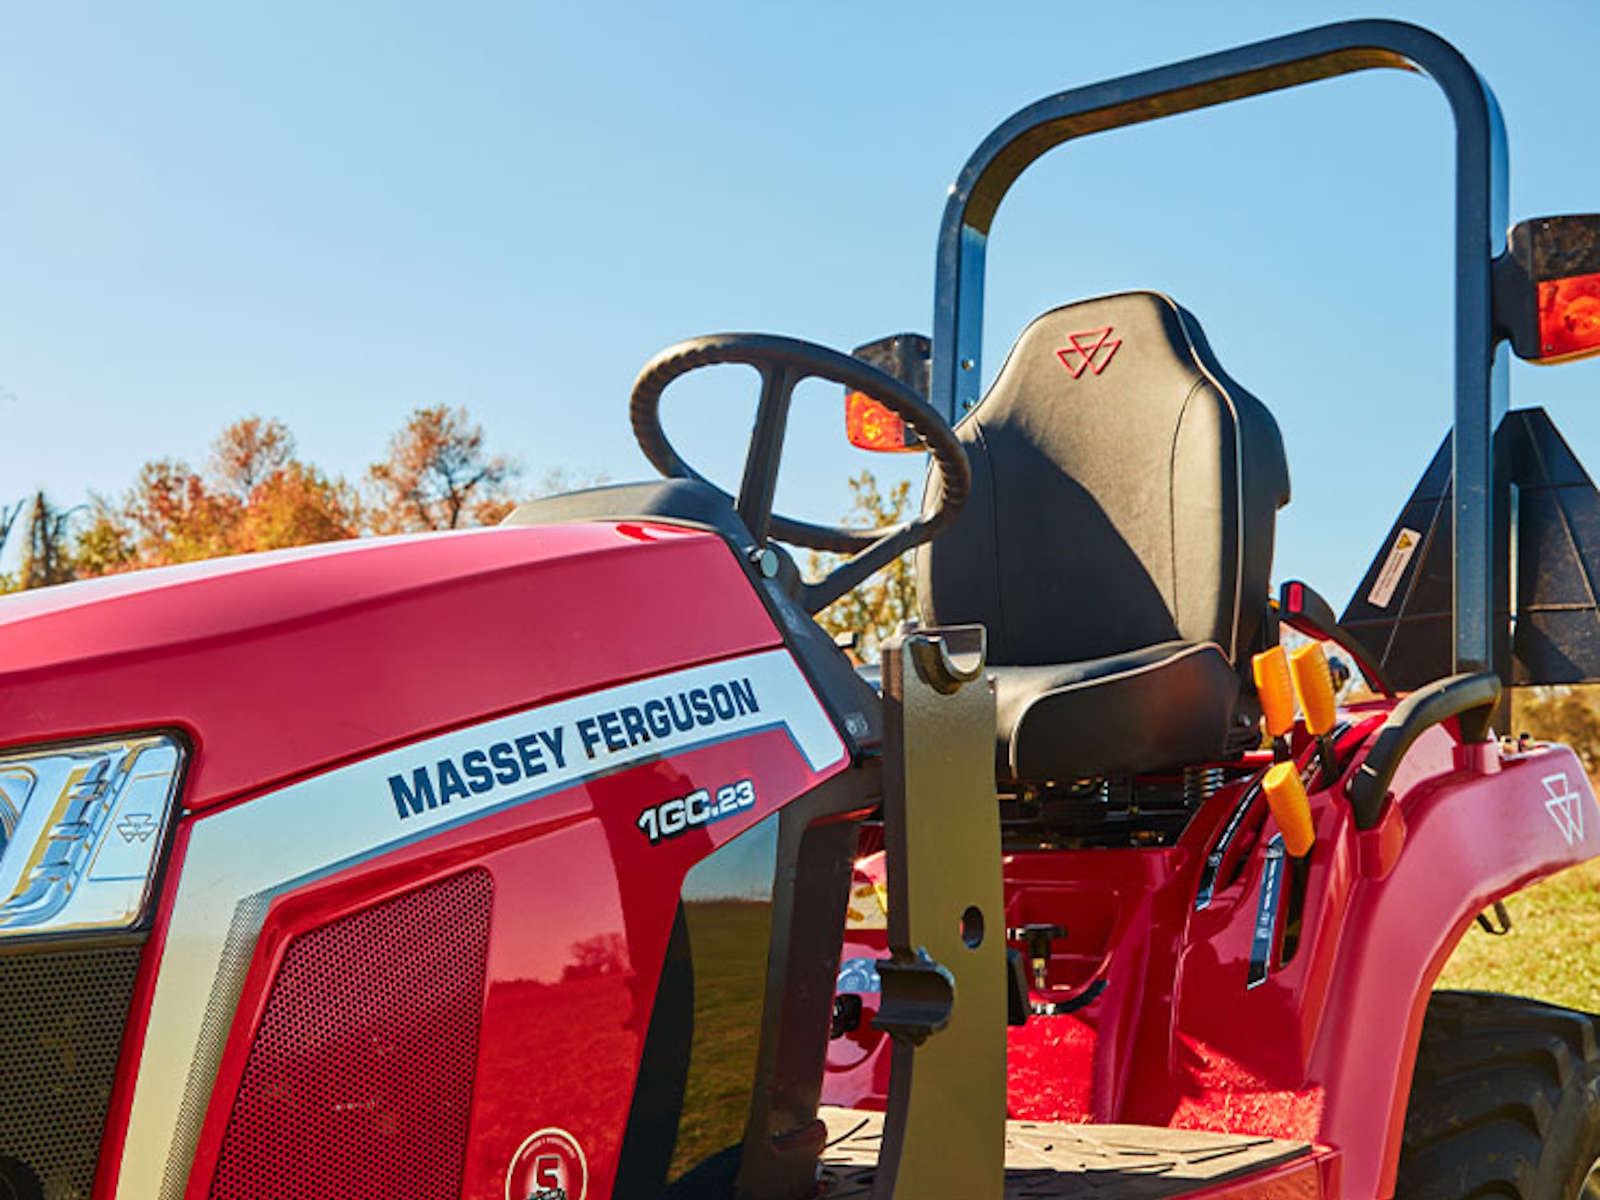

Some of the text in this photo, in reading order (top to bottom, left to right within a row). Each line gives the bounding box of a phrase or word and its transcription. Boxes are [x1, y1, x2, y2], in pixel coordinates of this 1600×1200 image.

[387, 678, 760, 819] MASSEY FERGUSON
[637, 779, 756, 844] 1GC.23
[535, 1155, 560, 1190] 5
